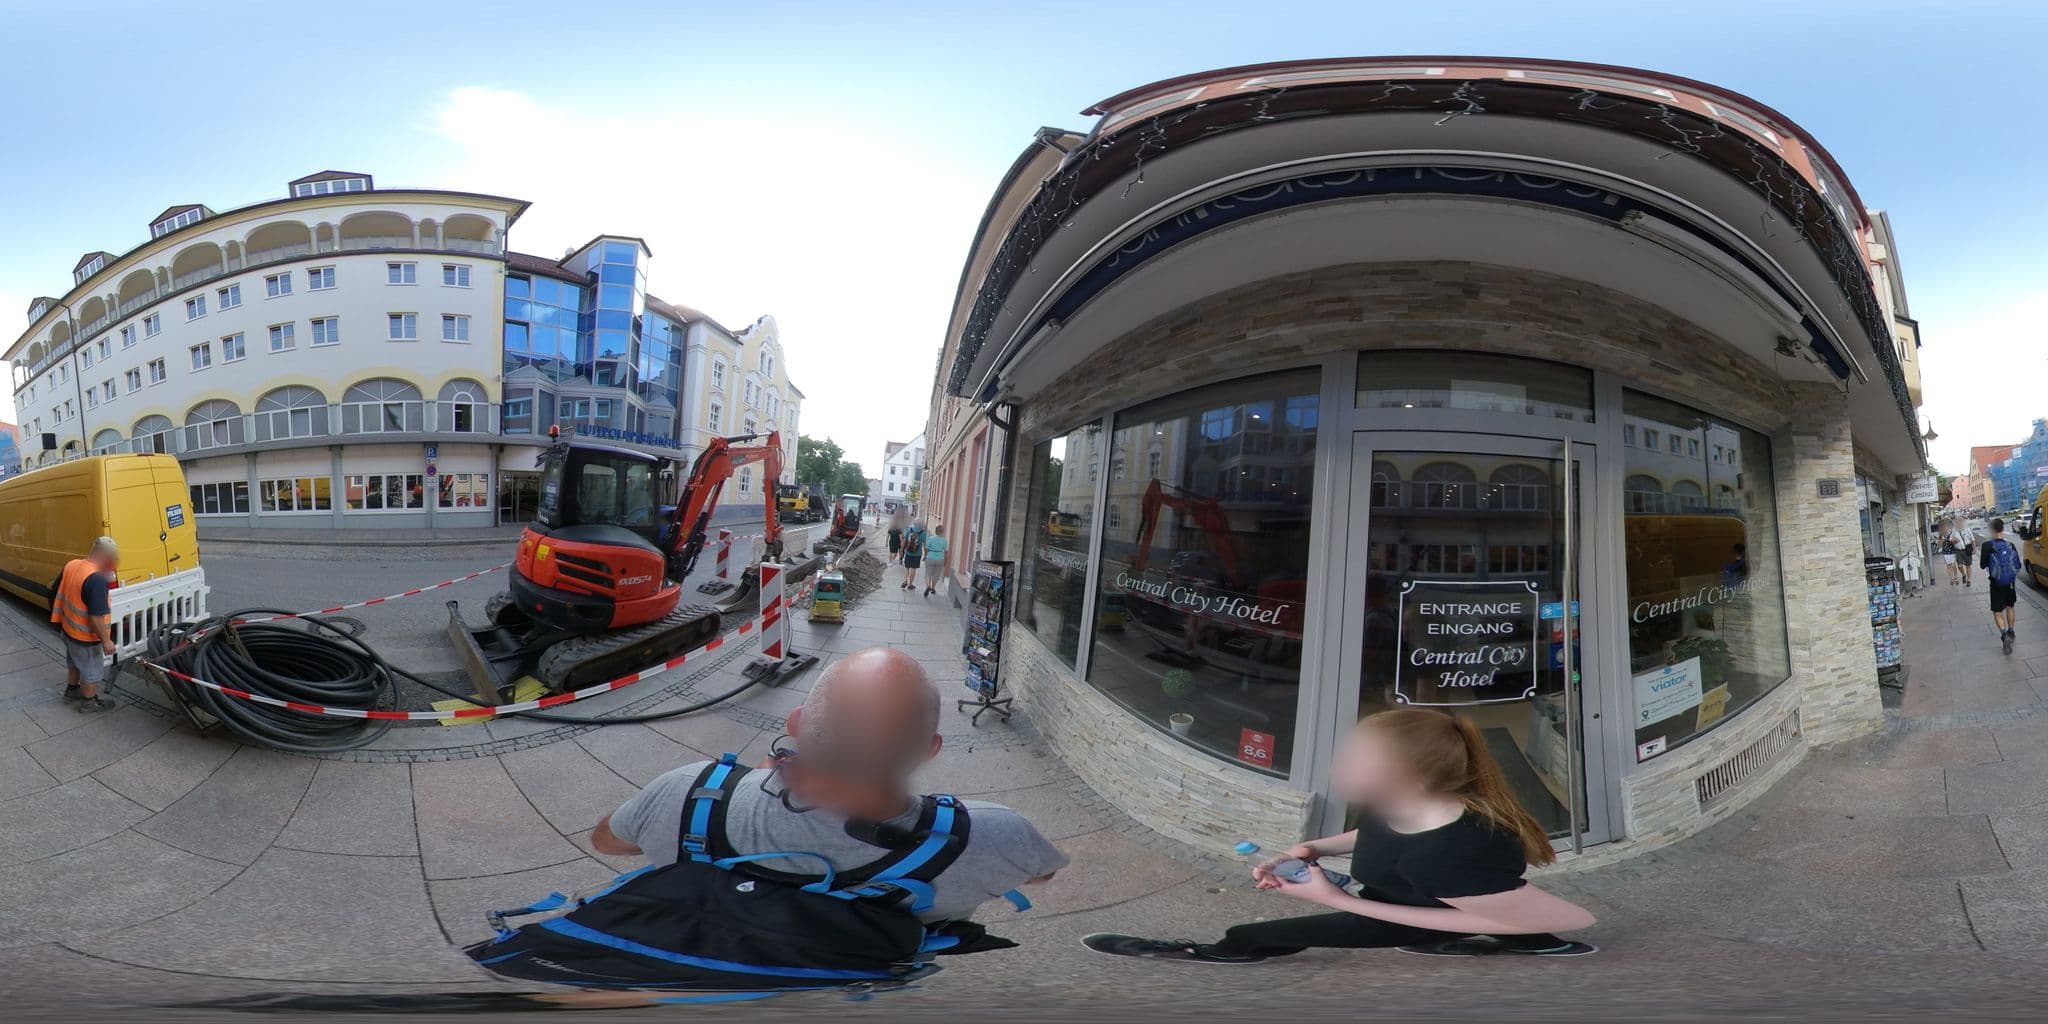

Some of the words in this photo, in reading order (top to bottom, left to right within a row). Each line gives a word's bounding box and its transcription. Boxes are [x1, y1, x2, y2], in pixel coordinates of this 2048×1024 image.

[1116, 572, 1173, 598] Central
[1171, 586, 1210, 613] City
[1213, 595, 1290, 625] Hotel
[1419, 602, 1522, 615] ENTRANCE
[1633, 587, 1706, 623] Central
[1707, 584, 1737, 604] City
[1427, 622, 1514, 635] EINGANG
[1410, 645, 1489, 666] Central
[1489, 646, 1526, 665] City
[1437, 666, 1501, 688] Hotel
[1651, 674, 1688, 692] viator
